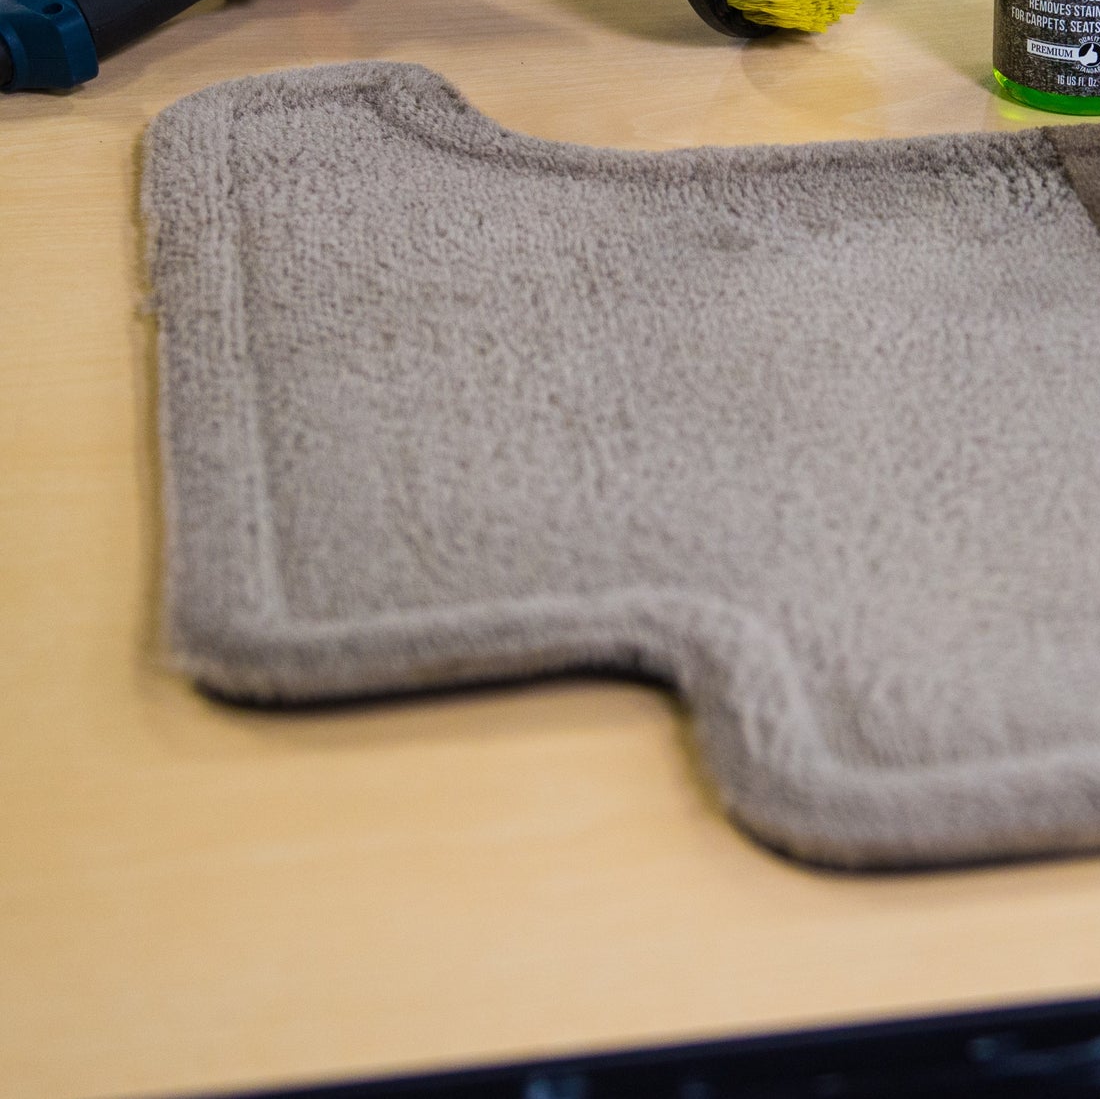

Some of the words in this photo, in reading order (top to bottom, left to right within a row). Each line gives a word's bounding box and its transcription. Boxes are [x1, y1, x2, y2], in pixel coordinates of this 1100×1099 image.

[1011, 5, 1025, 21] FOR
[1031, 43, 1073, 58] PREMIUM
[1057, 74, 1065, 85] 16
[1067, 75, 1077, 86] US
